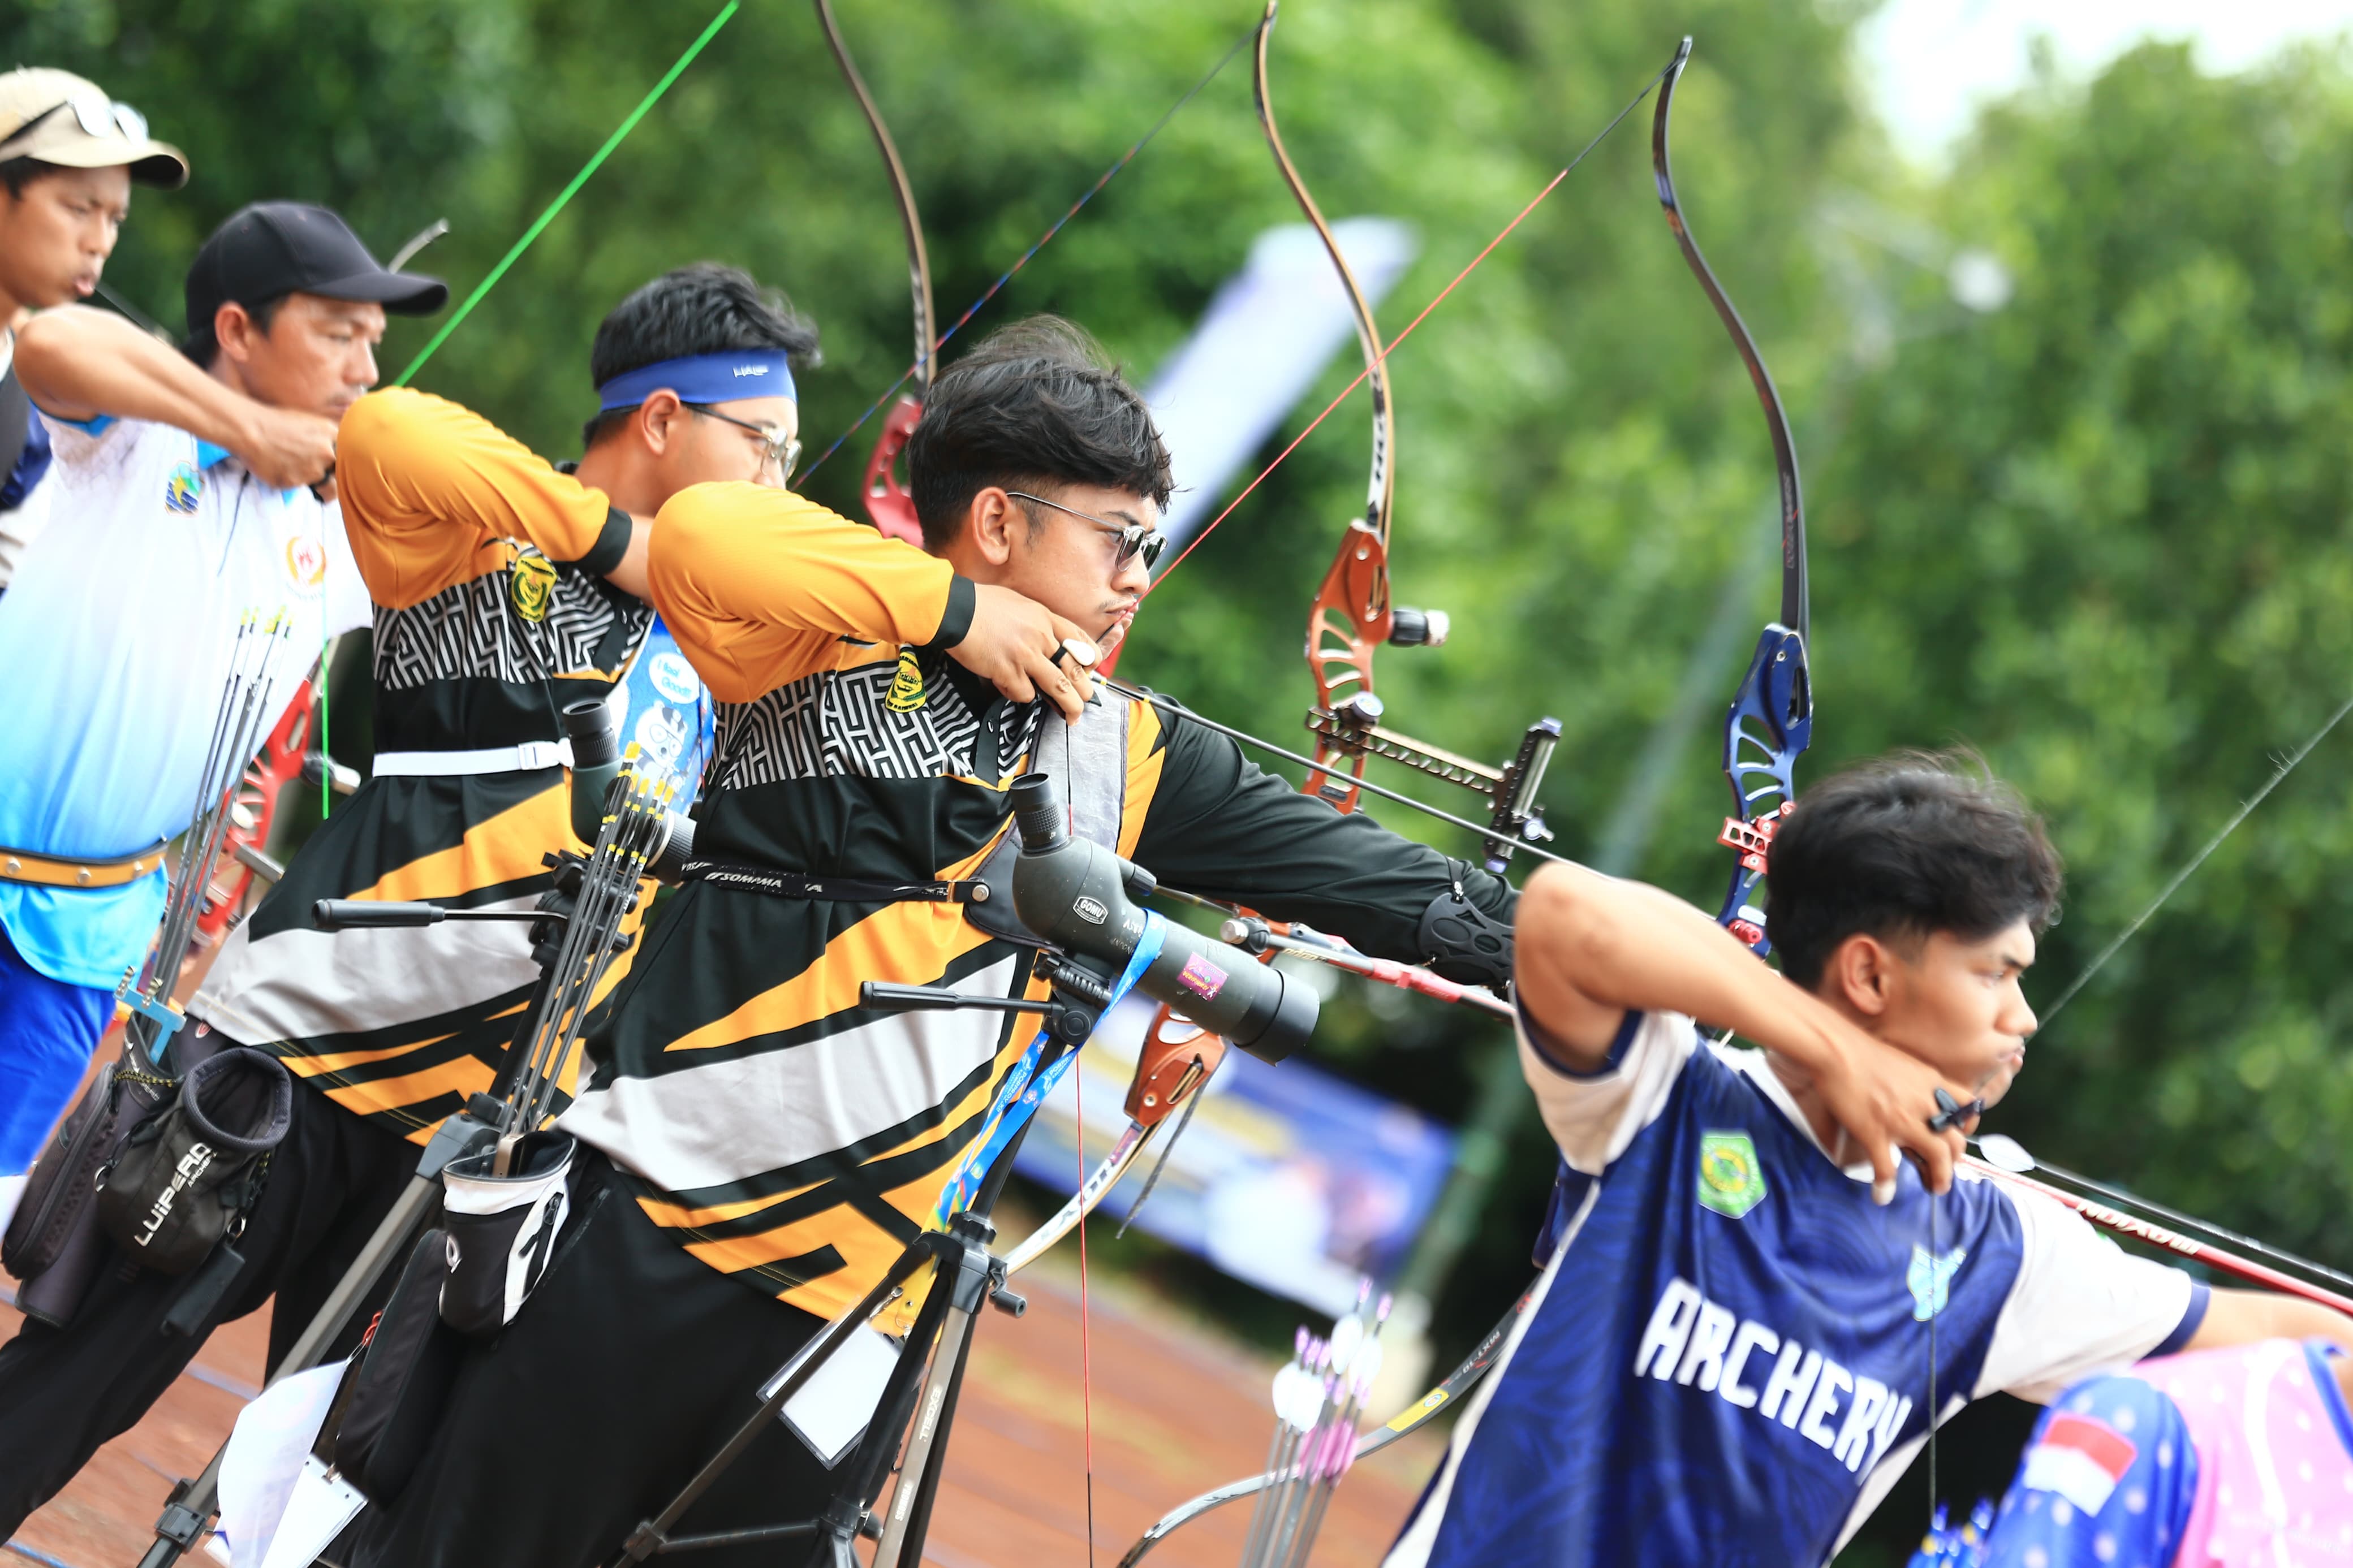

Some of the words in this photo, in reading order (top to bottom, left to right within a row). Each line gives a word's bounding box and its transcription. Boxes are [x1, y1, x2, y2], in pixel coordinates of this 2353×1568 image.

[1080, 900, 1104, 917] GOMU
[1003, 1071, 1027, 1103] PORPROV
[2075, 1199, 2204, 1255] MAXION
[1633, 1276, 1913, 1487] ARCHERY
[919, 1385, 943, 1441] EXCELL
